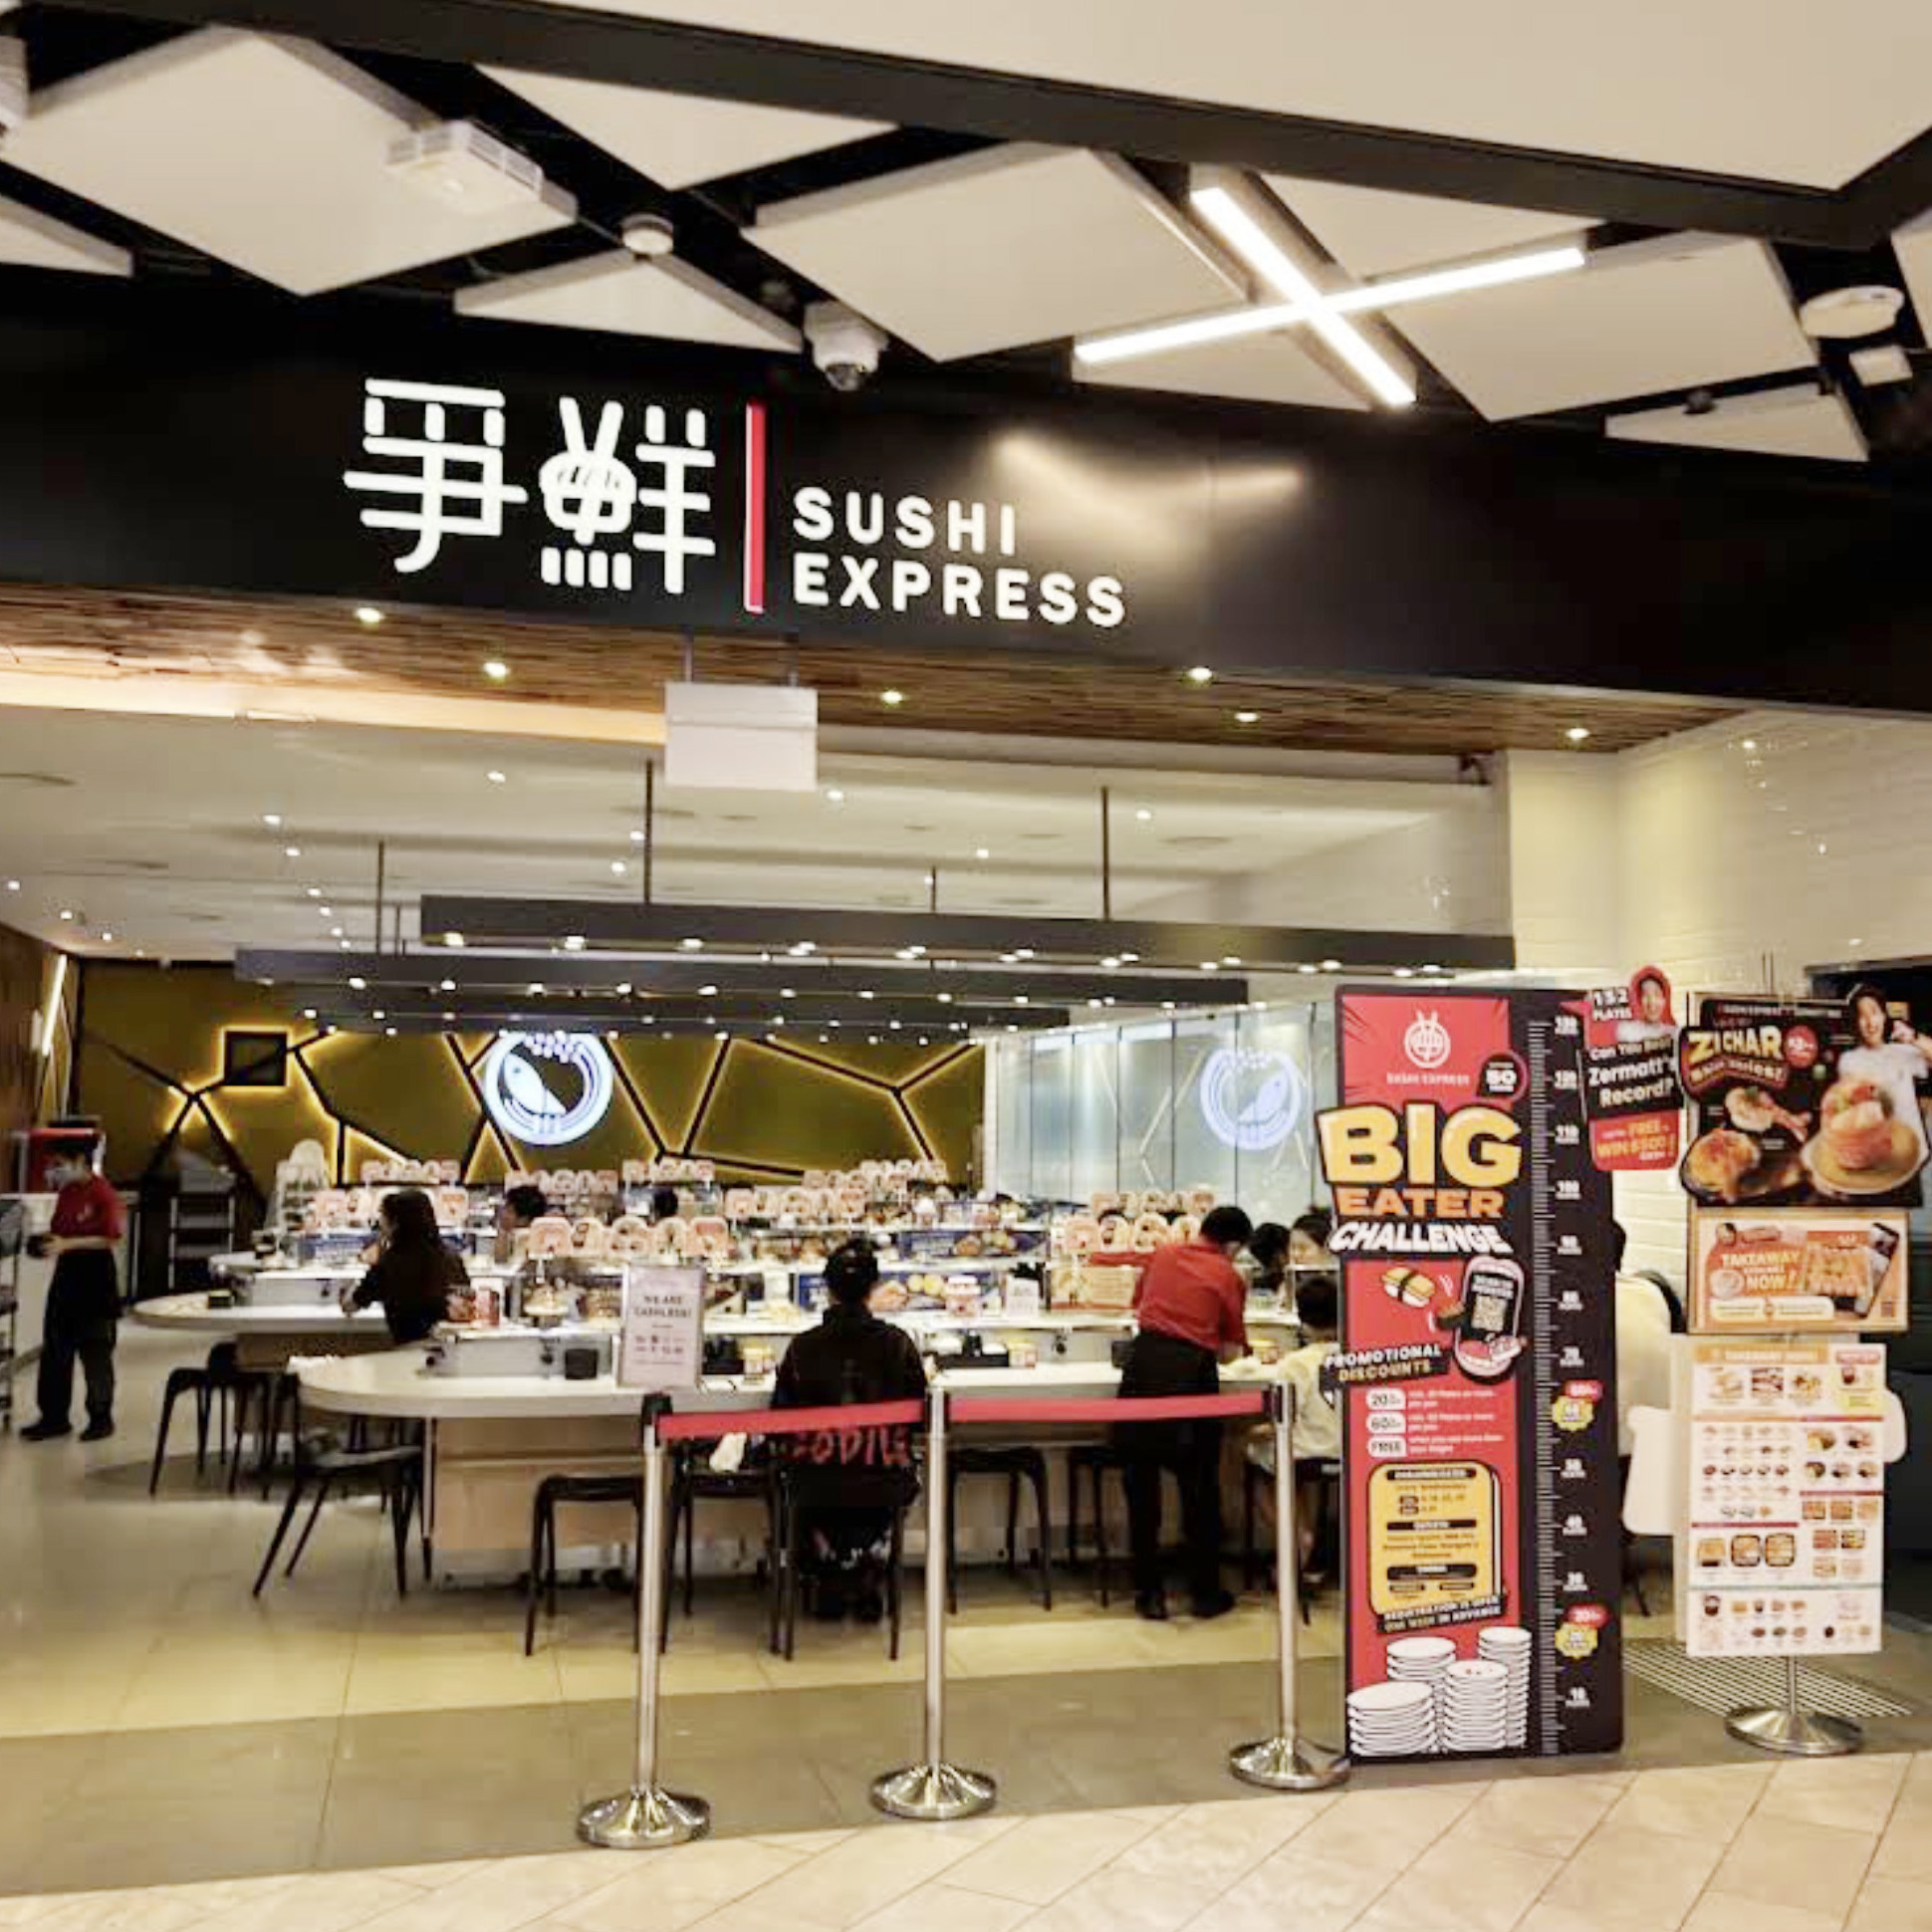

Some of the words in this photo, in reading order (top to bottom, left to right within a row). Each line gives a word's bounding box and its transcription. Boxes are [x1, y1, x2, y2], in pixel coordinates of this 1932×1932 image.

[794, 485, 1017, 557] SUSHI
[794, 551, 1127, 628] EXPRESS
[1318, 1102, 1523, 1188] BIG
[1335, 1187, 1506, 1218] EATER
[1328, 1221, 1514, 1253] CHALLENGE
[1326, 1343, 1442, 1369] PROMOTIONAL
[1338, 1358, 1431, 1382] DISCOUNTS
